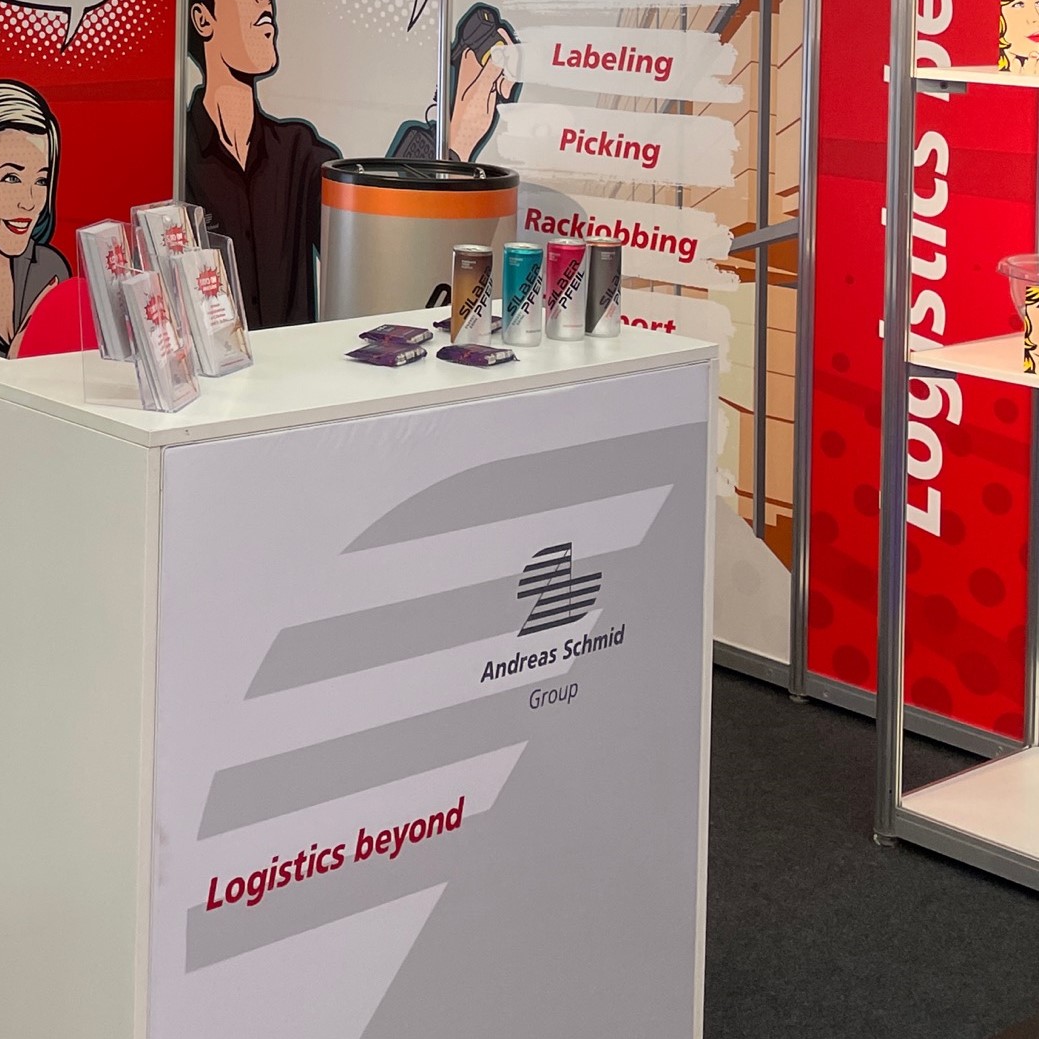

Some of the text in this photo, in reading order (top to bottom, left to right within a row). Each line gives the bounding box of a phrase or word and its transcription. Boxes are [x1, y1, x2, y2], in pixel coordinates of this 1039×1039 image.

[551, 43, 673, 82] Labeling
[559, 128, 661, 169] Picking
[507, 263, 541, 316] SILBER
[548, 259, 580, 310] SILBER
[559, 270, 585, 309] PFEIL
[480, 624, 625, 683] Andreas Schmid
[529, 682, 578, 710] Group
[206, 796, 465, 912] Logistics beyond
